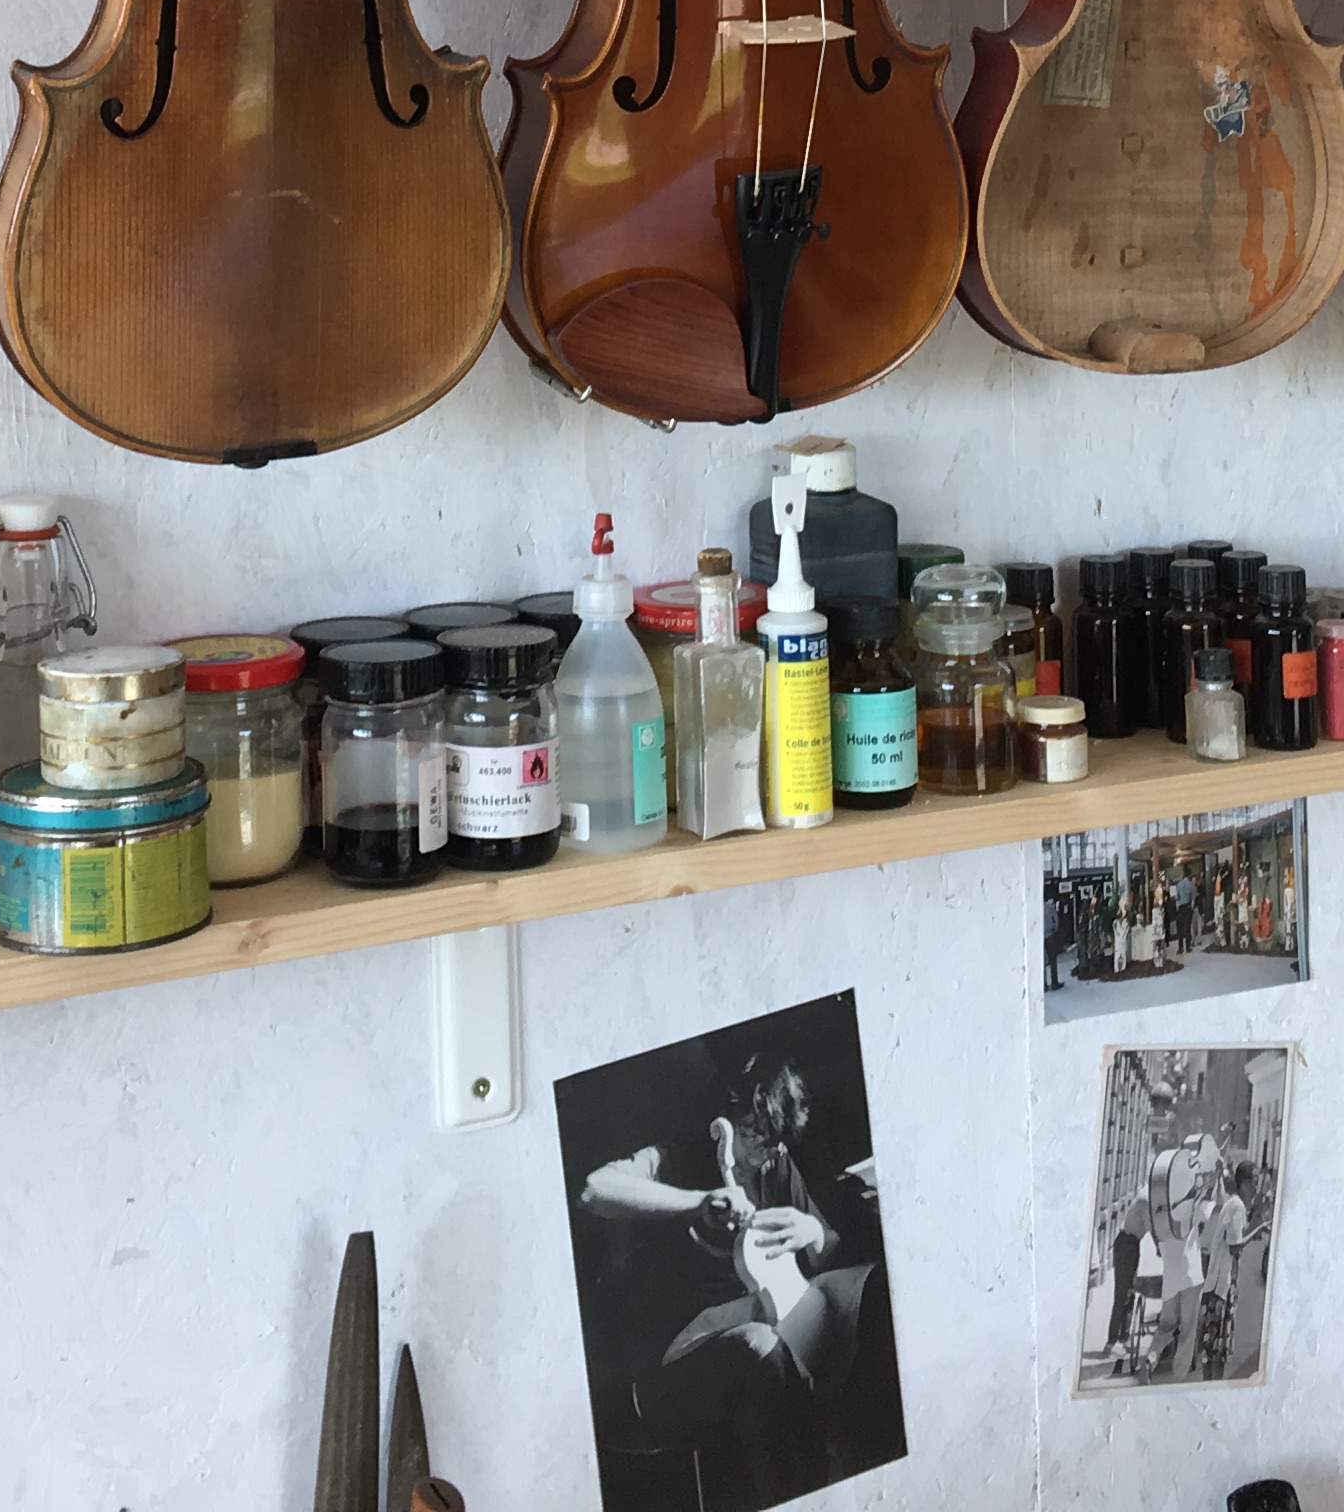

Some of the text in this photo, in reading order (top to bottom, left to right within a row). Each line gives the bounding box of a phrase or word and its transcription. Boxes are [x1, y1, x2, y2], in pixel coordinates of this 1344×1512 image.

[811, 737, 820, 747] de
[846, 733, 878, 746] Huile
[882, 732, 896, 744] de
[871, 750, 903, 765] 50 ml
